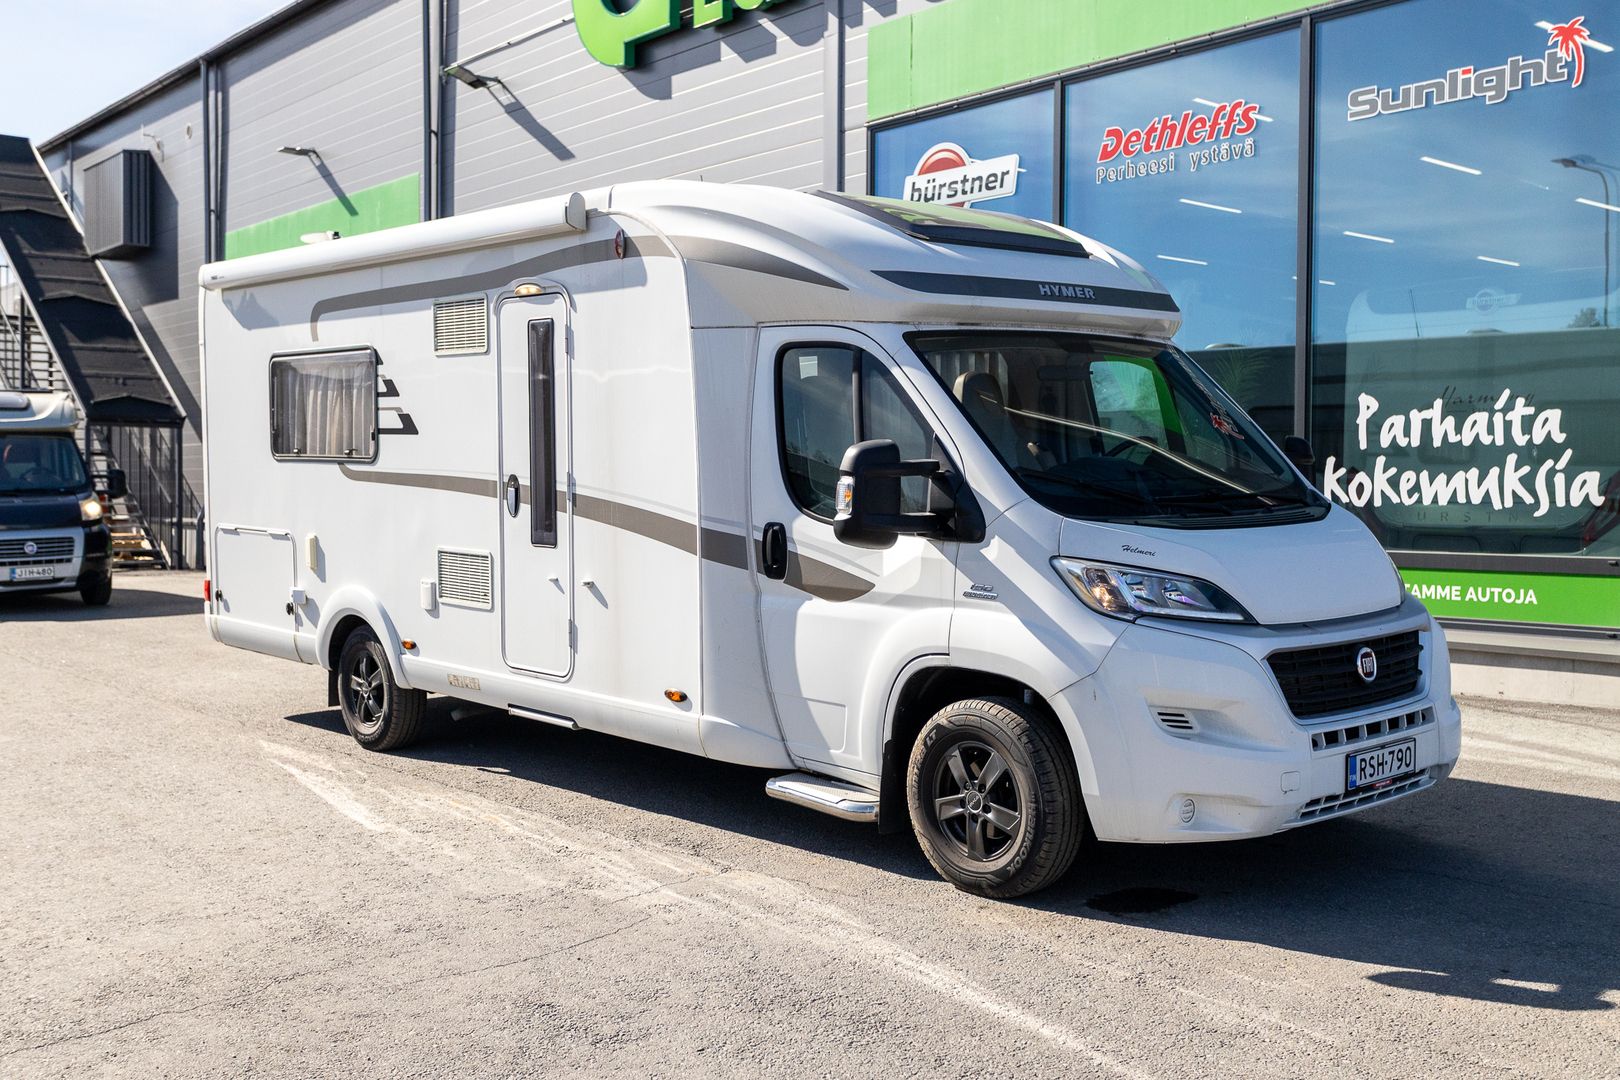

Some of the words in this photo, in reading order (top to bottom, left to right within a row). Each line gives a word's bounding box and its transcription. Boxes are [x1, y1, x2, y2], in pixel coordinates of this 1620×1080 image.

[1347, 48, 1568, 121] Sunlight
[1097, 99, 1259, 163] Dethleffs
[1096, 152, 1175, 184] Perheesi
[1190, 138, 1255, 172] ystävä
[910, 169, 1010, 203] bürstner
[1038, 283, 1096, 299] HYMER
[1356, 387, 1567, 451] Parhaita
[1323, 447, 1606, 518] kokemuksia
[1121, 544, 1157, 557] Helmeri
[1465, 586, 1538, 605] AUTOJA
[1359, 745, 1412, 781] RSH-790
